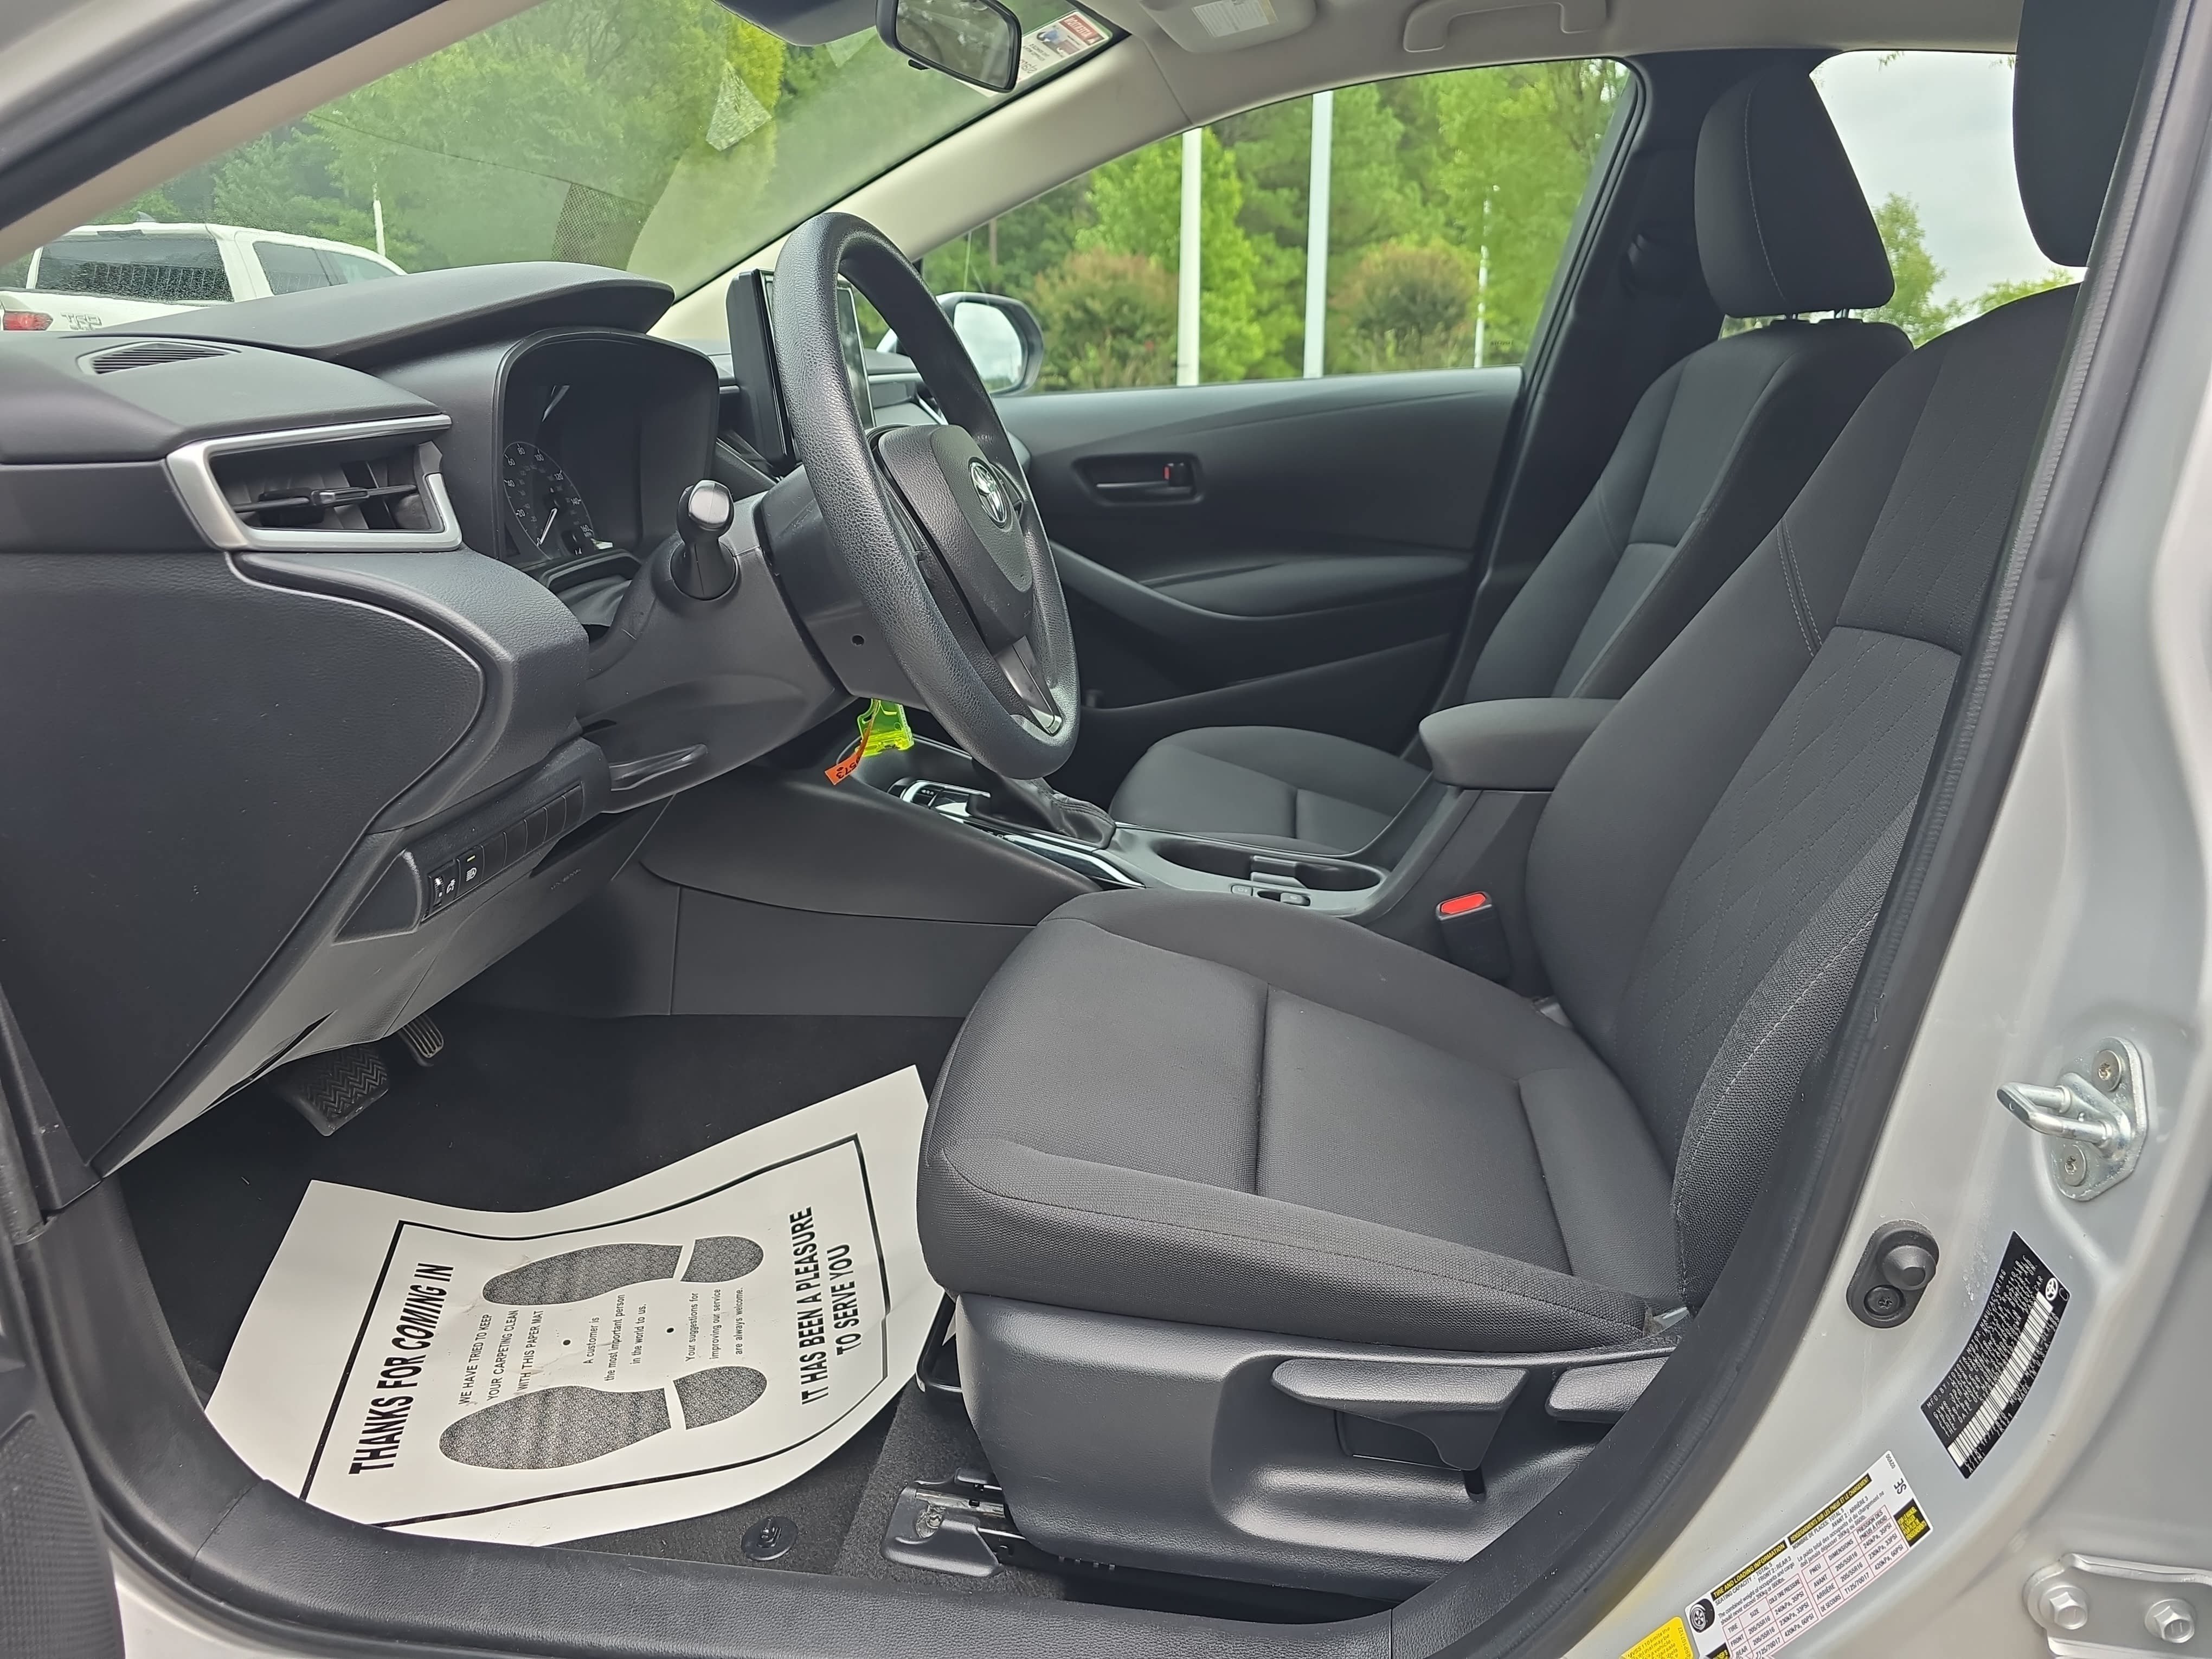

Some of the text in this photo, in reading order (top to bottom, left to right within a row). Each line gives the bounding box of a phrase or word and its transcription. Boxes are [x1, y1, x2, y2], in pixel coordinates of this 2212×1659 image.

[638, 1304, 646, 1314] us.
[711, 1289, 721, 1311] service
[734, 1288, 743, 1315] welcome.
[791, 1206, 828, 1405] IT HAS BEEN A PLEASURE
[827, 1244, 861, 1355] TO SERVE YOU
[587, 1325, 598, 1356] customer
[604, 1295, 625, 1381] the most important person
[634, 1326, 644, 1344] world
[685, 1293, 699, 1361] Your suggestions for
[709, 1325, 722, 1359] improving
[734, 1317, 745, 1340] always
[349, 1263, 454, 1474] THANKS FOR COMING IN
[458, 1314, 492, 1405] WE HAVE TRIED TO KEEP
[487, 1310, 519, 1401] YOUR CARPETING CLEAN
[517, 1310, 543, 1391] WITH THIS PAPER MAT
[631, 1346, 642, 1356] the
[1894, 1478, 1907, 1494] SE
[1792, 1536, 1809, 1550] NOMBRE
[1829, 1512, 1842, 1522] TOTAL
[1803, 1547, 1814, 1560] poids
[1813, 1541, 1822, 1550] total
[1829, 1521, 1849, 1538] occupants
[1857, 1496, 1879, 1515] chargement
[1809, 1509, 1883, 1575] PNEU DIMENSIONS PRESSION DES
[1831, 1517, 1844, 1529] AVANT
[1859, 1528, 1873, 1541] PNEUS
[1713, 1544, 1785, 1598] TIRE AND LOADING INFORMATION
[1800, 1559, 1808, 1568] doit
[1808, 1551, 1821, 1564] jamais
[1813, 1574, 1828, 1588] AVANT
[1835, 1551, 1858, 1572] 205/55R16
[1863, 1535, 1881, 1549] 240kPa,
[1880, 1522, 1892, 1534] 35PSI
[1816, 1533, 1898, 1600] ARRIÈRE 205/55R16 230kPa, 33PSI
[1715, 1591, 1733, 1606] SEATING
[1732, 1578, 1752, 1594] CAPACITY
[1756, 1566, 1770, 1576] TOTAL
[1758, 1571, 1772, 1583] FRONT
[1825, 1594, 1842, 1609] SECOURS
[1844, 1572, 1870, 1594] T125/70D17
[1874, 1555, 1892, 1571] 420kPa,
[1891, 1544, 1904, 1557] 60PSI
[1728, 1624, 1739, 1633] TIRE
[1750, 1609, 1760, 1618] SIZE
[1731, 1634, 1744, 1647] FRONT
[1748, 1616, 1771, 1635] 205/55R16
[1792, 1591, 1804, 1603] 35PSI
[1752, 1627, 1775, 1645] 205/55R16
[1796, 1602, 1809, 1613] 33PSI
[1801, 1613, 1815, 1625] 60PSI
